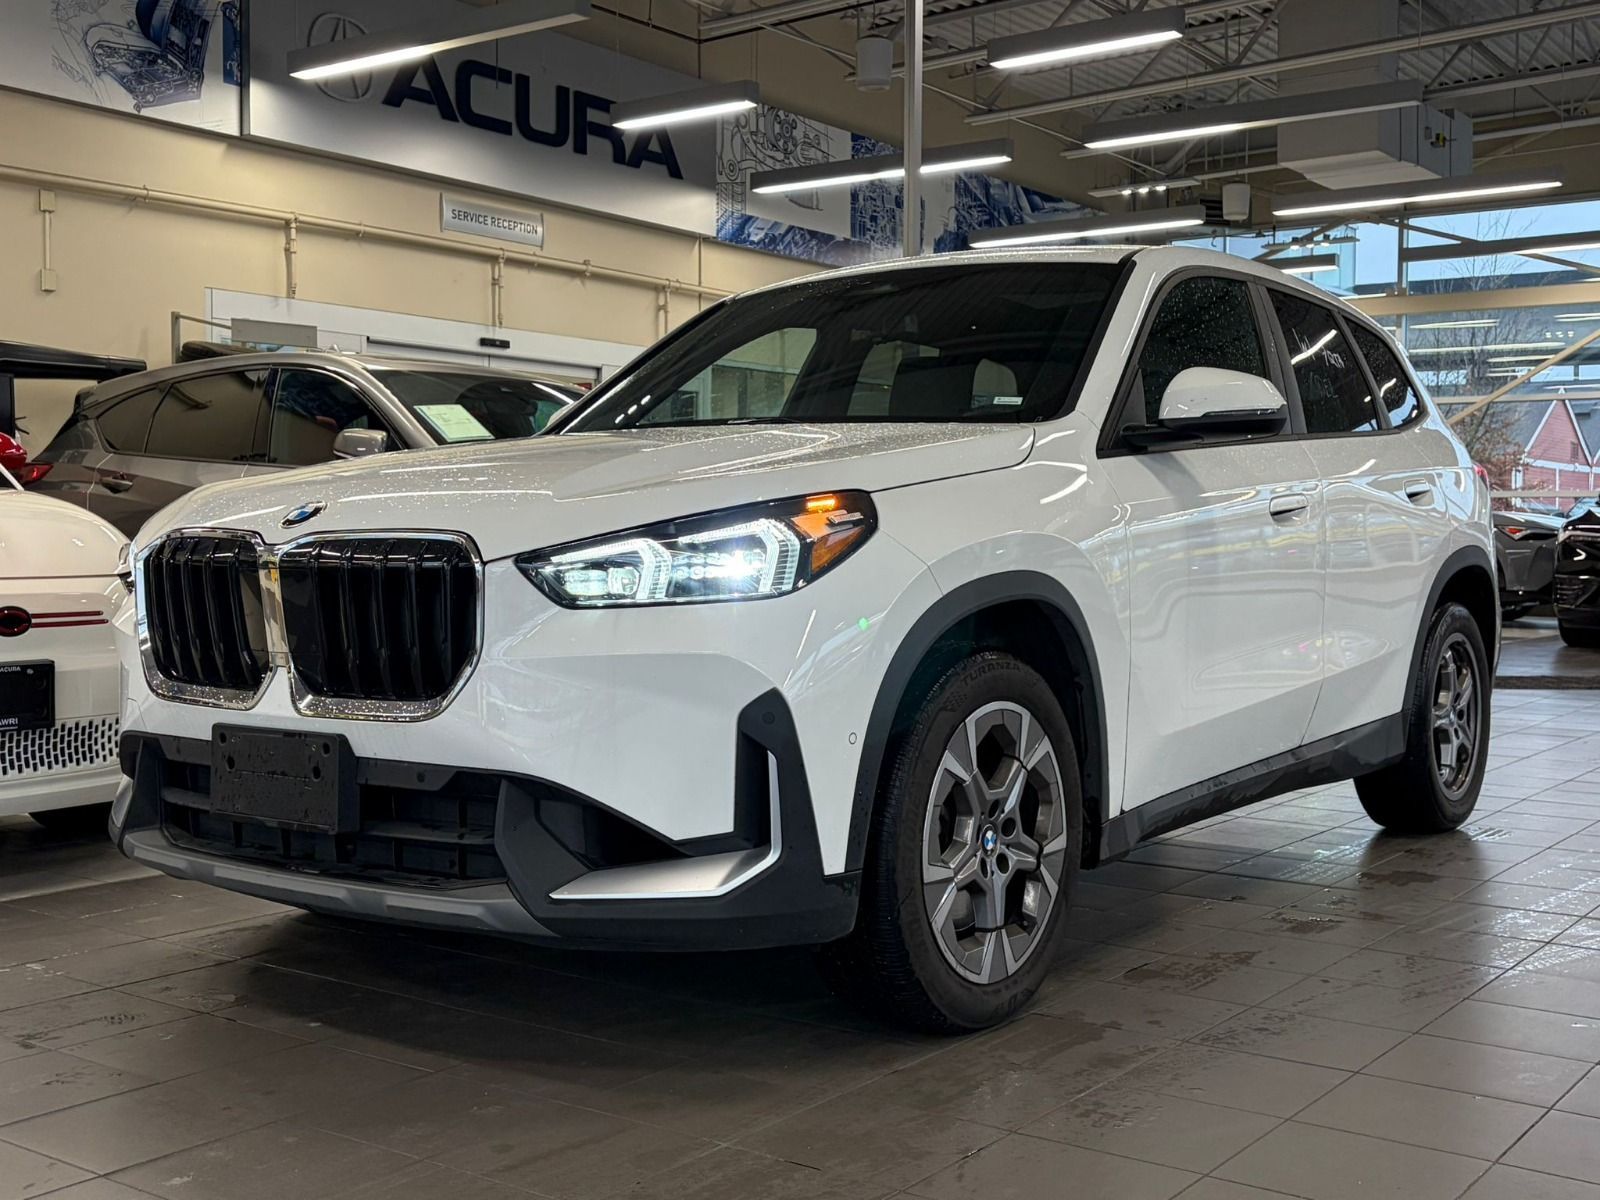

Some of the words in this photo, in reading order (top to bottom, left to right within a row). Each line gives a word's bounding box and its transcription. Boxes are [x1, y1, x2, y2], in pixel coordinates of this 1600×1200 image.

[381, 54, 684, 180] ACURA
[451, 208, 489, 226] SERVICE
[490, 216, 538, 236] RECEPTION
[961, 661, 1021, 687] TURANZA
